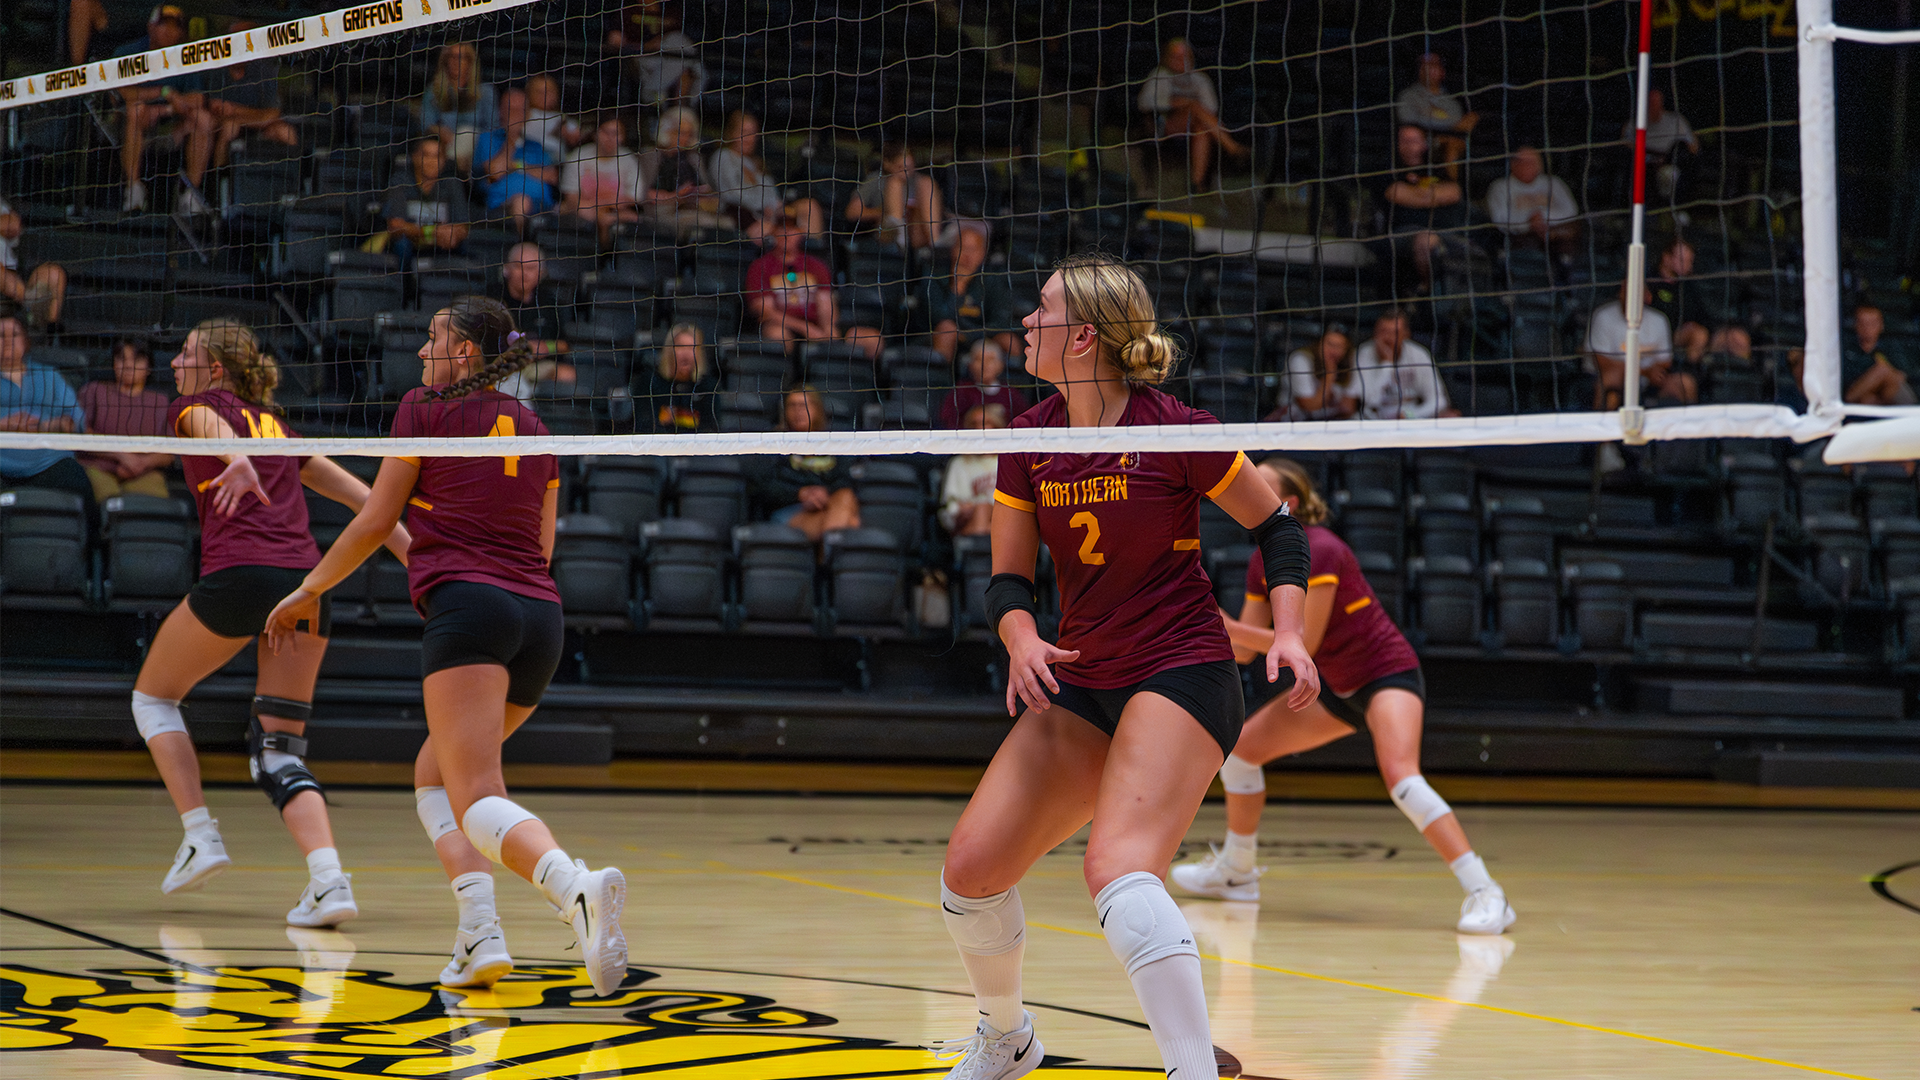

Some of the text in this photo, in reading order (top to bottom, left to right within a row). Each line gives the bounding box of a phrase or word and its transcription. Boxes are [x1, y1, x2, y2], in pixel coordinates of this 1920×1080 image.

[0, 0, 404, 100] WSU GRIFFONS MWSU GRIFFONS MWSU GRIFFONS
[1040, 474, 1128, 507] NORTHERN
[1069, 511, 1106, 566] 2
